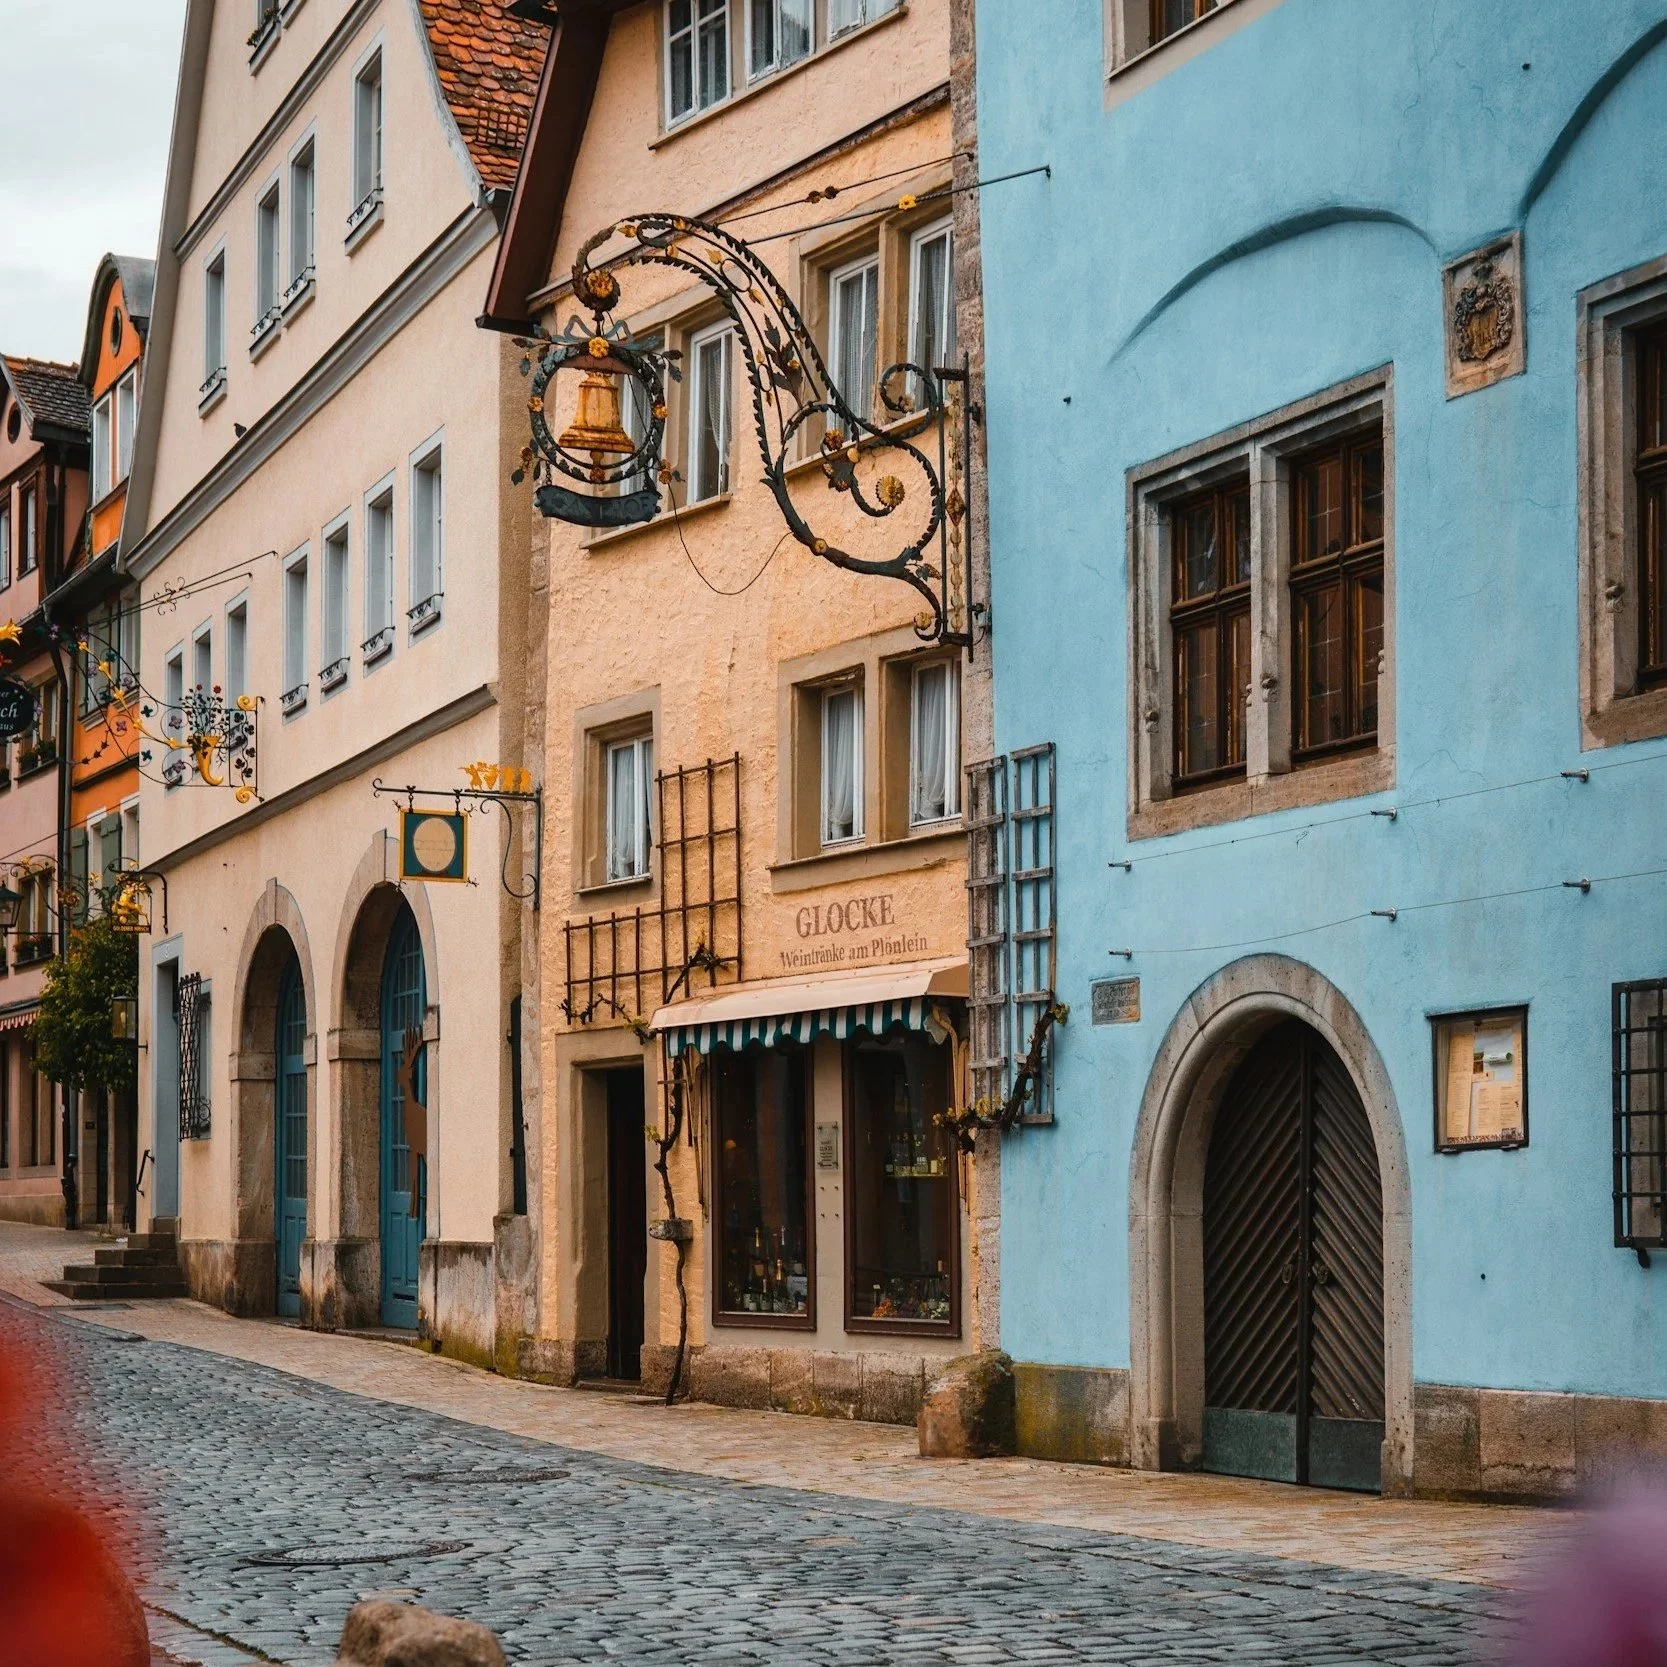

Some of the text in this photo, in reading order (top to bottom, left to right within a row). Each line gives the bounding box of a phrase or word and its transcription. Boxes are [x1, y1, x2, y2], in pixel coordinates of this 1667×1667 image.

[0, 702, 18, 718] ch
[796, 894, 895, 938] GLOCKE
[780, 932, 928, 969] Weintränke am Plönlein
